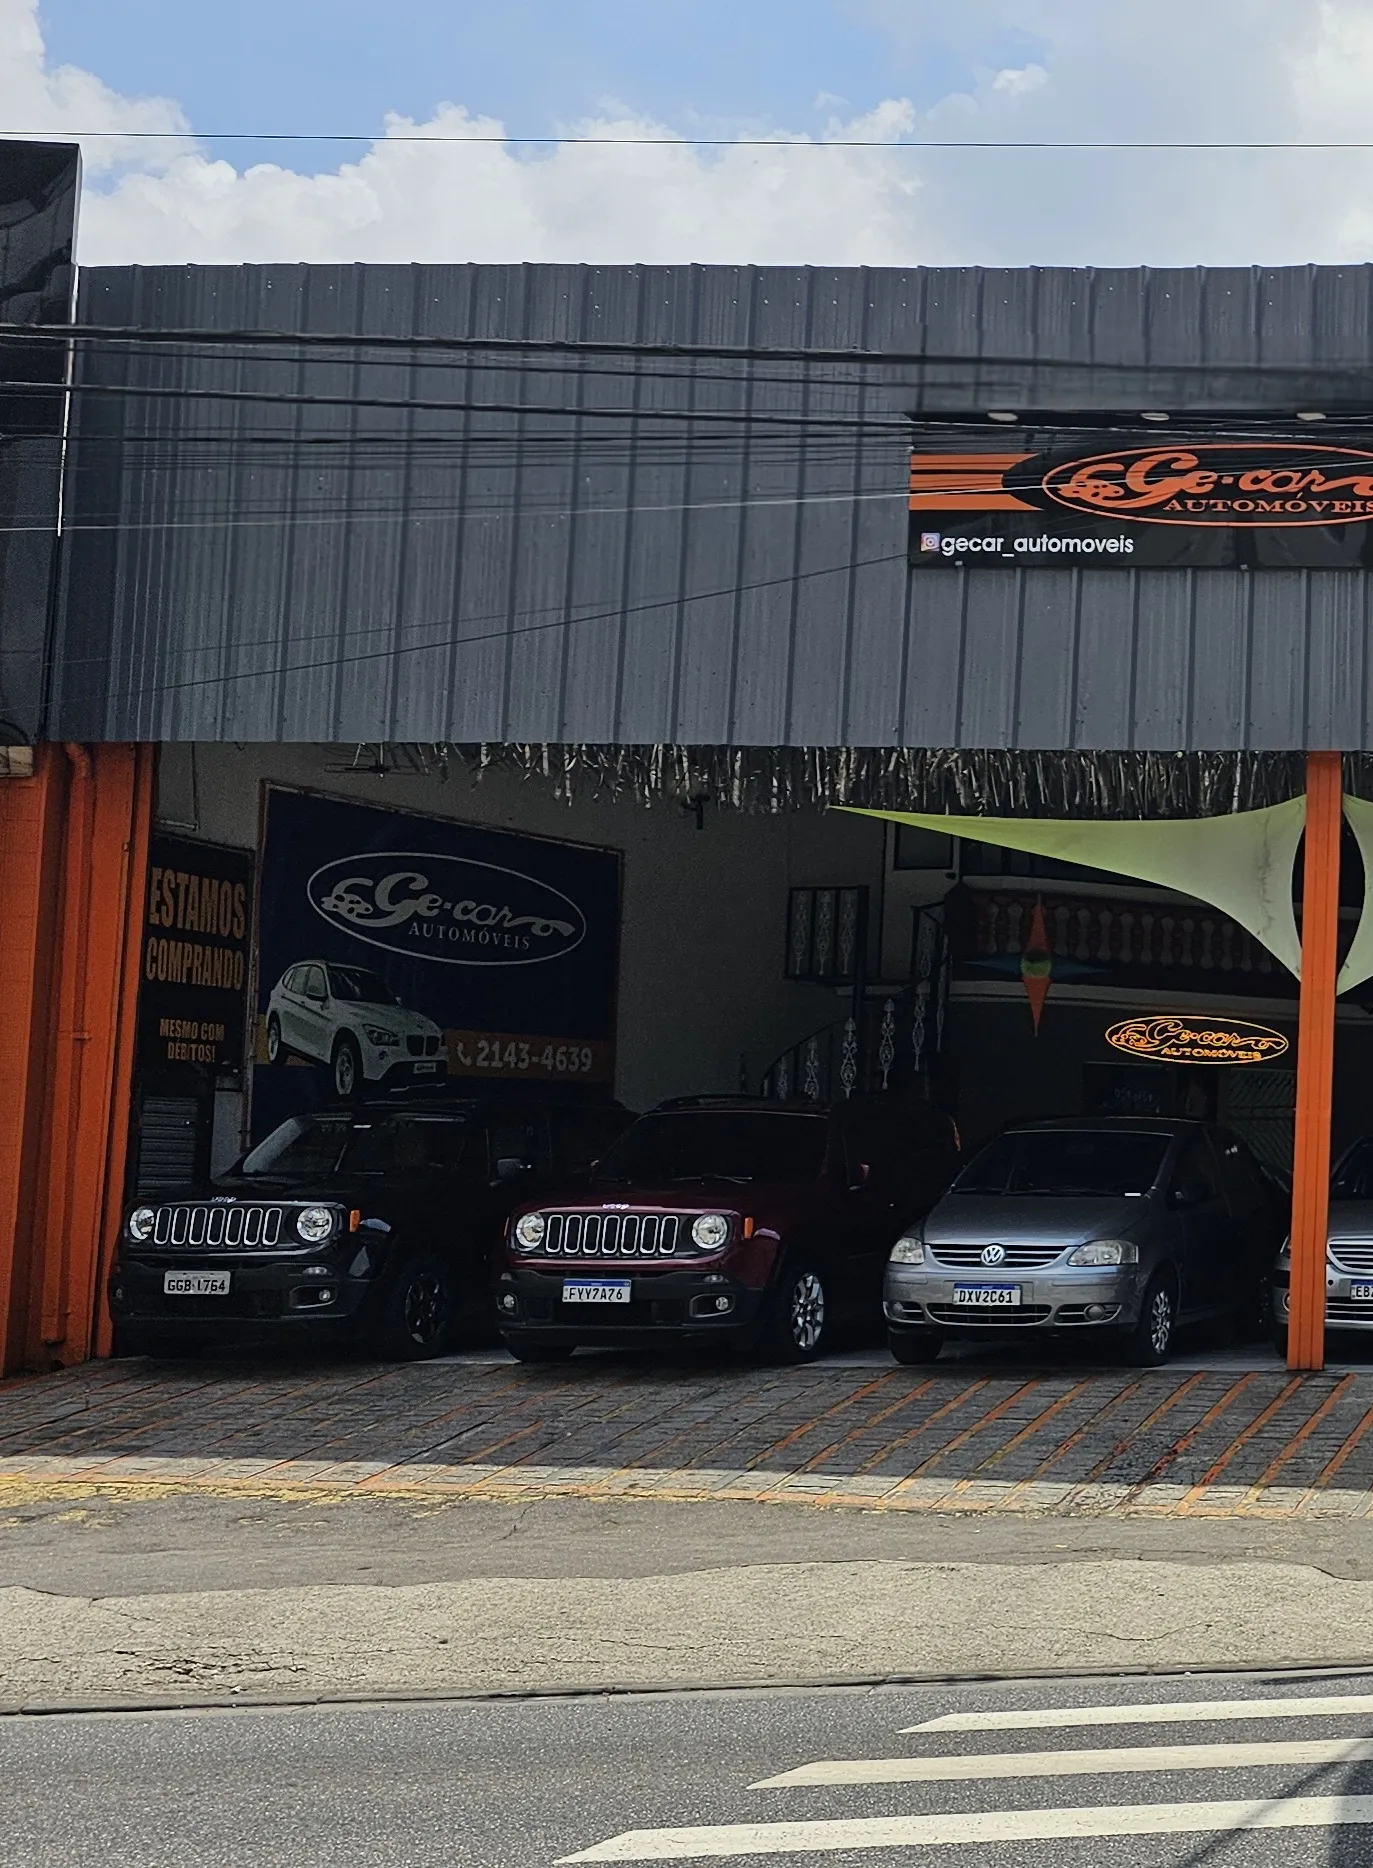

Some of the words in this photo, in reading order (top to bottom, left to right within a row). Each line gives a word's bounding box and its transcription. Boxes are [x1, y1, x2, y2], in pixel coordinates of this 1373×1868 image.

[940, 534, 1134, 557] gecar_automoveis
[149, 867, 246, 939] ESTAMOS
[408, 921, 531, 950] AUTOMÓVEIS
[145, 936, 244, 991] COMPRANDO
[159, 1018, 198, 1040] MESMO
[201, 1022, 225, 1042] COM
[476, 1039, 592, 1072] 2143-4639
[569, 1287, 623, 1300] FYY7A76
[959, 1290, 1012, 1303] DXV2C61
